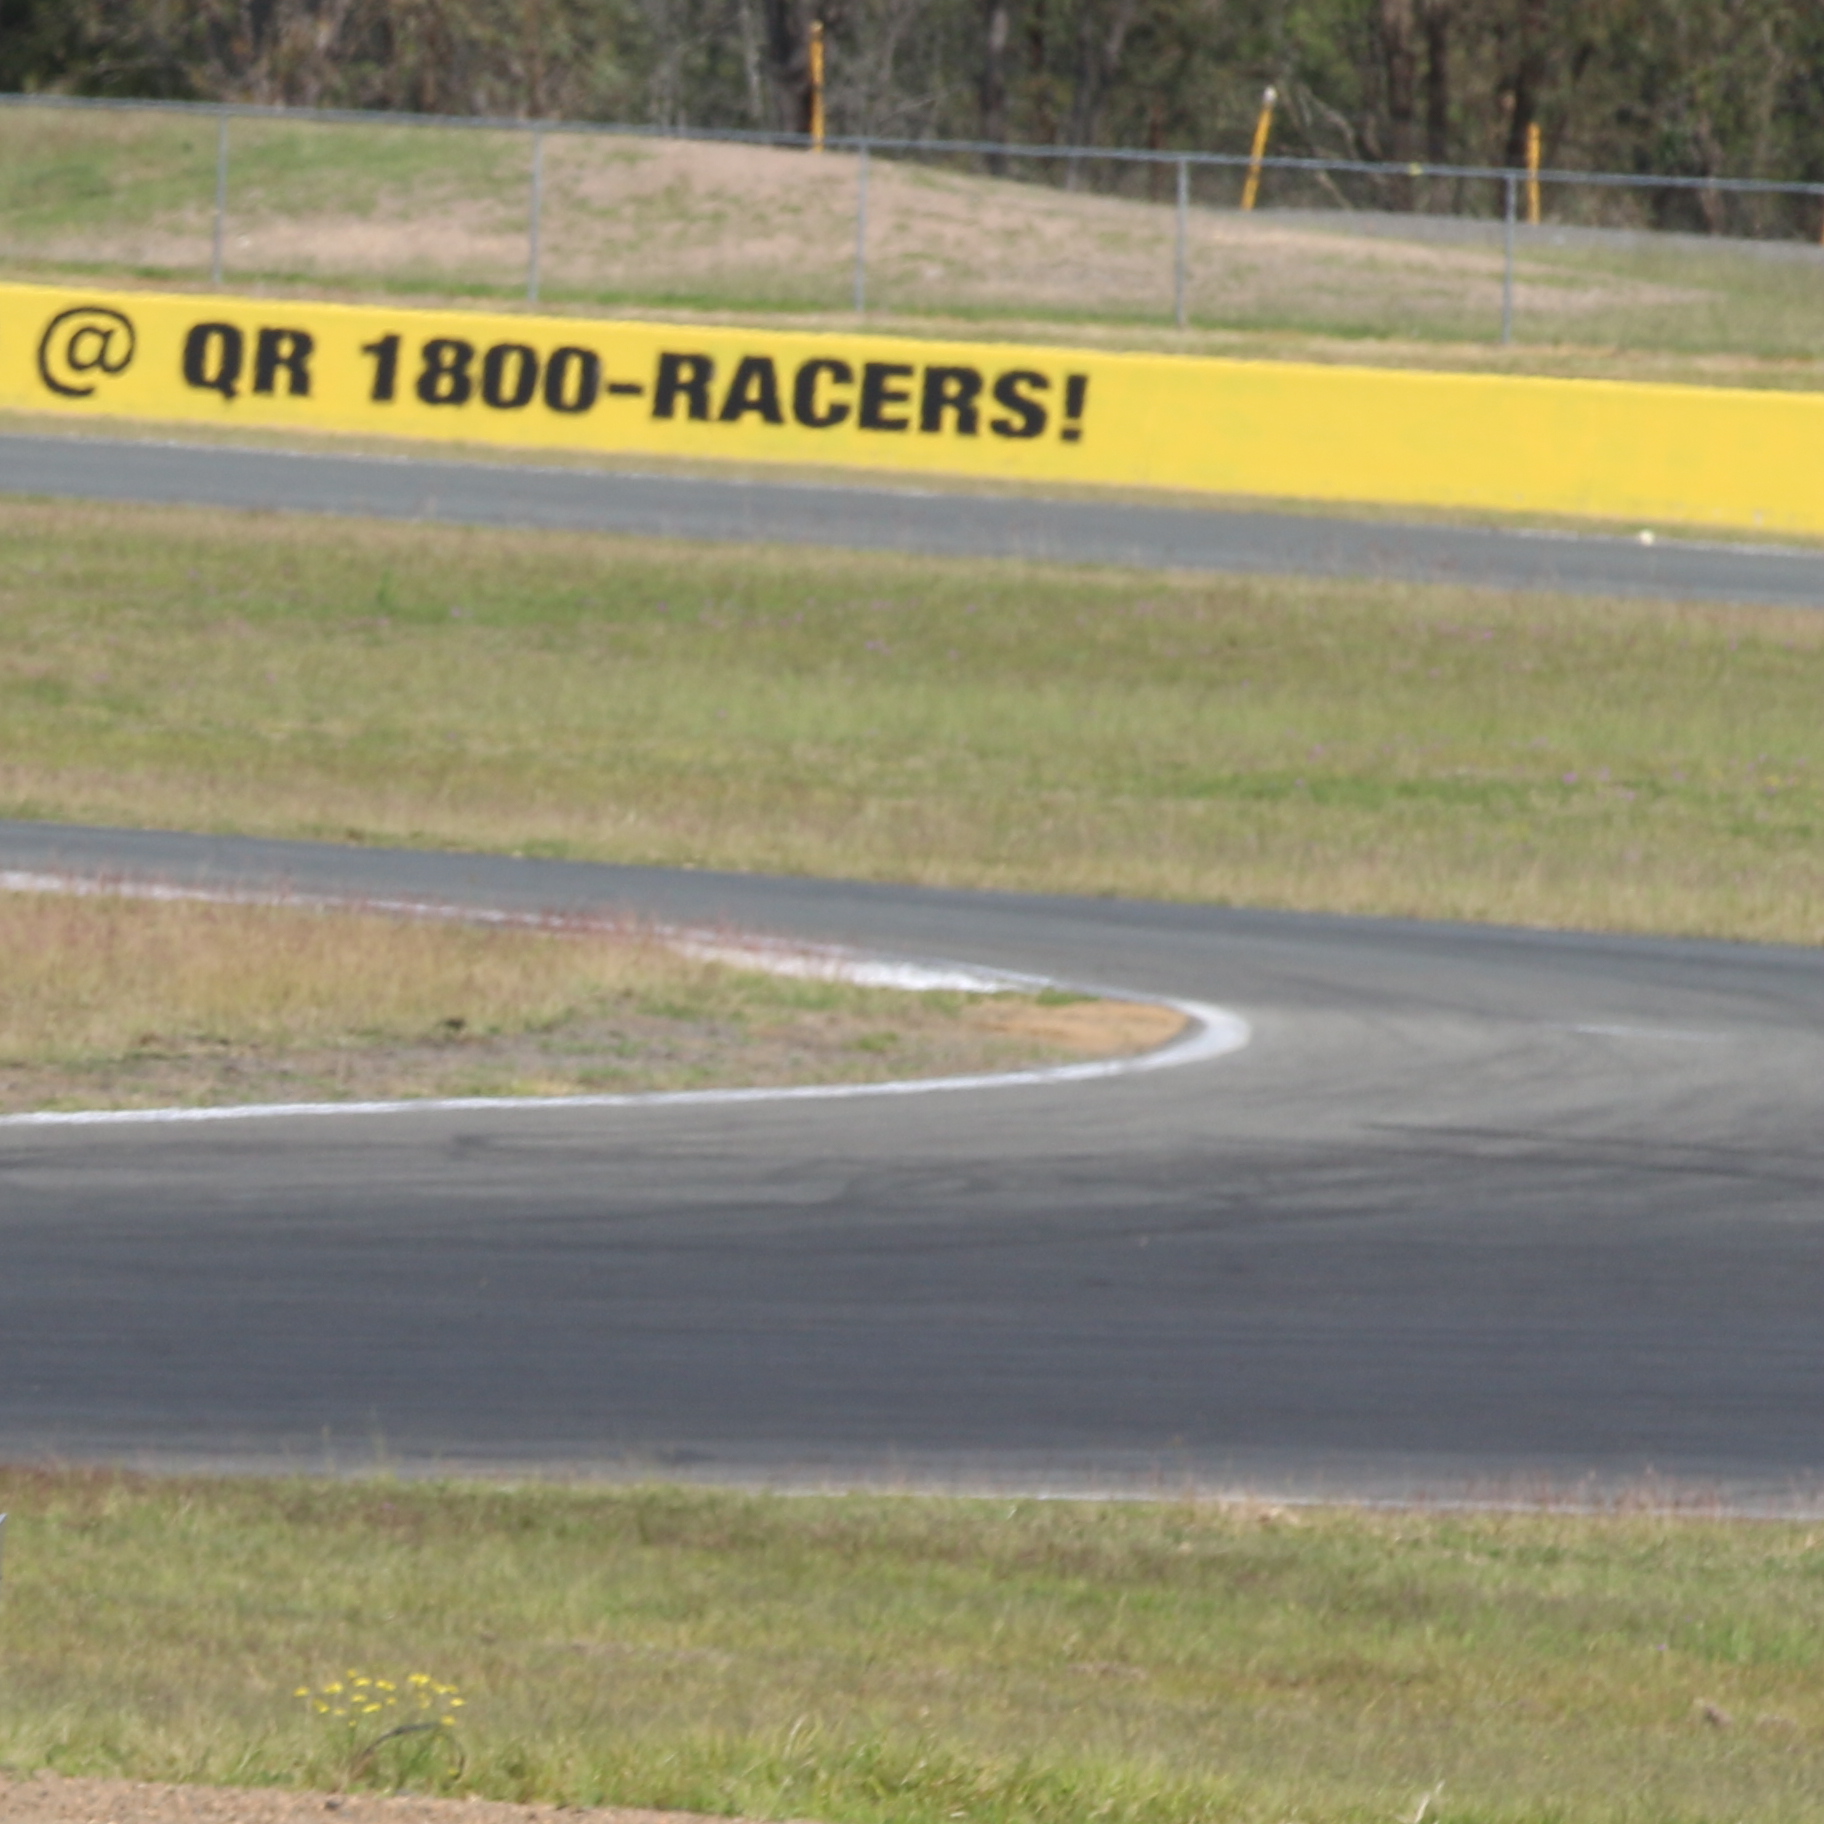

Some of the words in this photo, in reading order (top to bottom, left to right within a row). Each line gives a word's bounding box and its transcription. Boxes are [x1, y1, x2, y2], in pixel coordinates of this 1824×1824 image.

[37, 306, 136, 398] @
[182, 321, 315, 401] QR
[361, 332, 1090, 443] 1800-RACERS!
